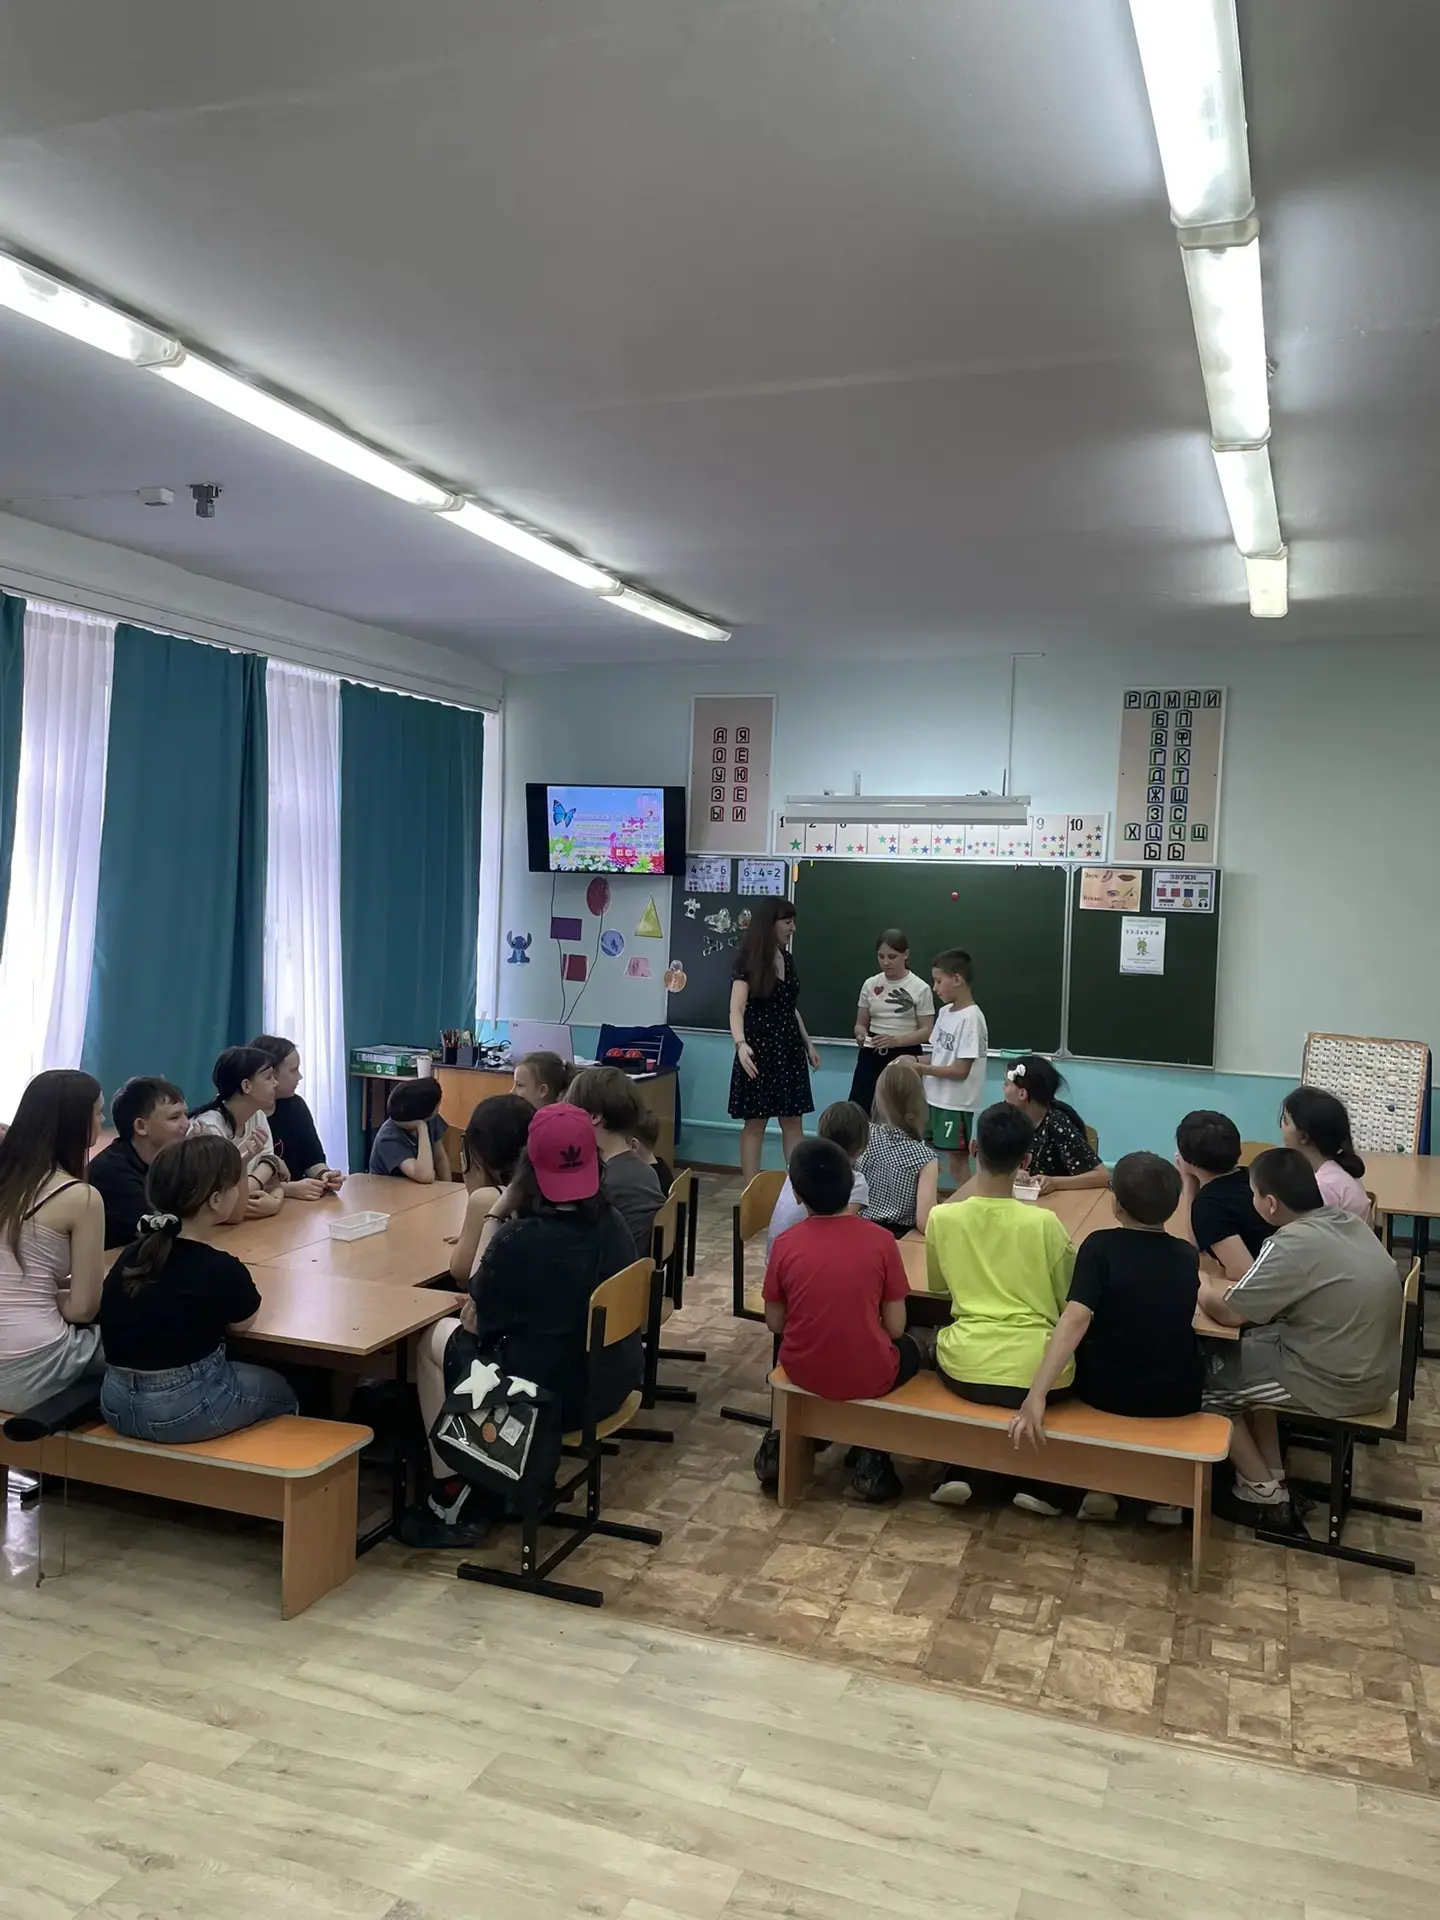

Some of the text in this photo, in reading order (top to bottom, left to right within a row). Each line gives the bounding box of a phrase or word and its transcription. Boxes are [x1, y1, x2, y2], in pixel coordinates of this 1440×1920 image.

[1128, 694, 1138, 707] Р
[1146, 694, 1157, 707] Л
[1167, 694, 1177, 706] М
[1187, 693, 1197, 706] Н
[1155, 712, 1188, 726] Б П
[716, 730, 747, 742] А Я
[1154, 732, 1188, 745] В Ф
[1153, 751, 1187, 763] Г К
[715, 770, 746, 781] У Ю
[1151, 770, 1185, 783] Д Т
[736, 789, 744, 800] Е
[1151, 789, 1184, 802] Ж Ш
[735, 809, 743, 820] И
[1150, 807, 1183, 820] З С
[779, 815, 1084, 831] 1 9 10
[1128, 826, 1205, 840] Х Ц Ч Щ
[1169, 873, 1197, 881] ЗВУКИ
[944, 1121, 954, 1138] 7
